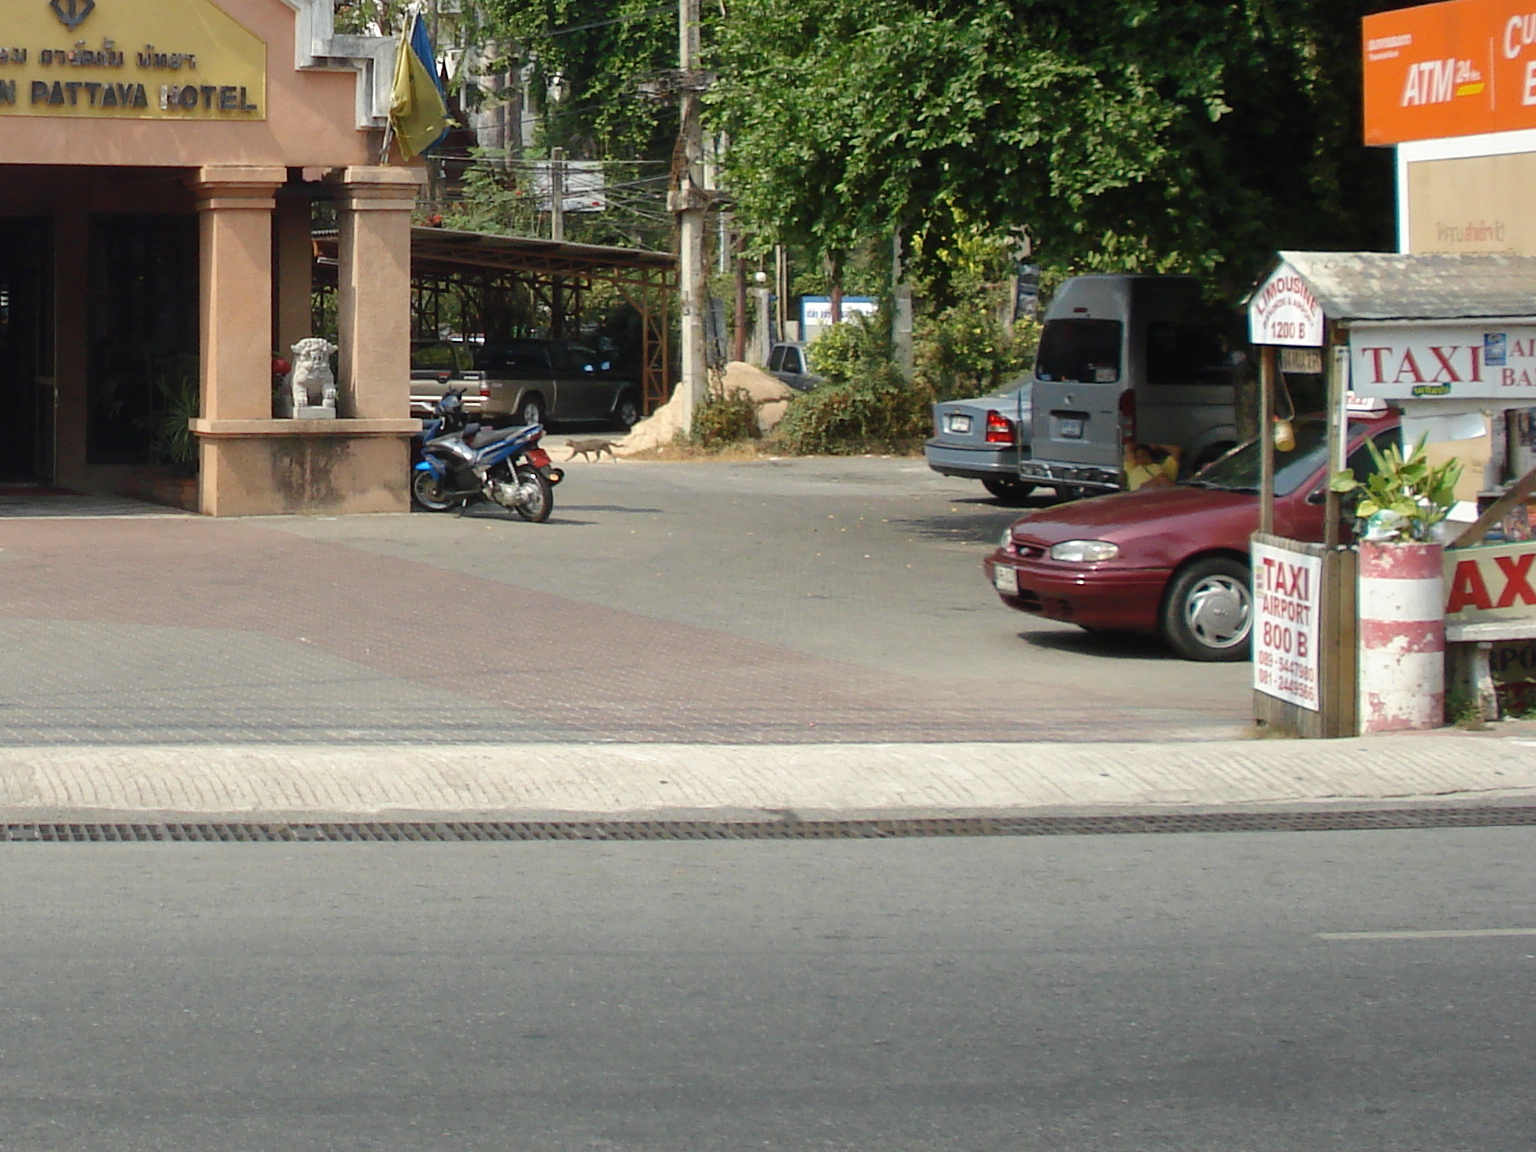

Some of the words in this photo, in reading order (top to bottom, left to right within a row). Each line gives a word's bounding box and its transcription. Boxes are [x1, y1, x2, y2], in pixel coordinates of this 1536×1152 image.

[31, 79, 148, 109] PATTAYA
[160, 83, 258, 114] HOTEL
[1401, 57, 1455, 107] ATM
[1256, 276, 1319, 317] LIMOUSINE
[1271, 322, 1296, 339] 1200
[1298, 322, 1306, 339] B
[1362, 345, 1484, 384] TAXI
[1501, 367, 1536, 387] BA
[1262, 556, 1310, 602] TAXI
[1262, 594, 1311, 627] AIRPORT
[1264, 621, 1292, 654] 800
[1297, 630, 1308, 658] B
